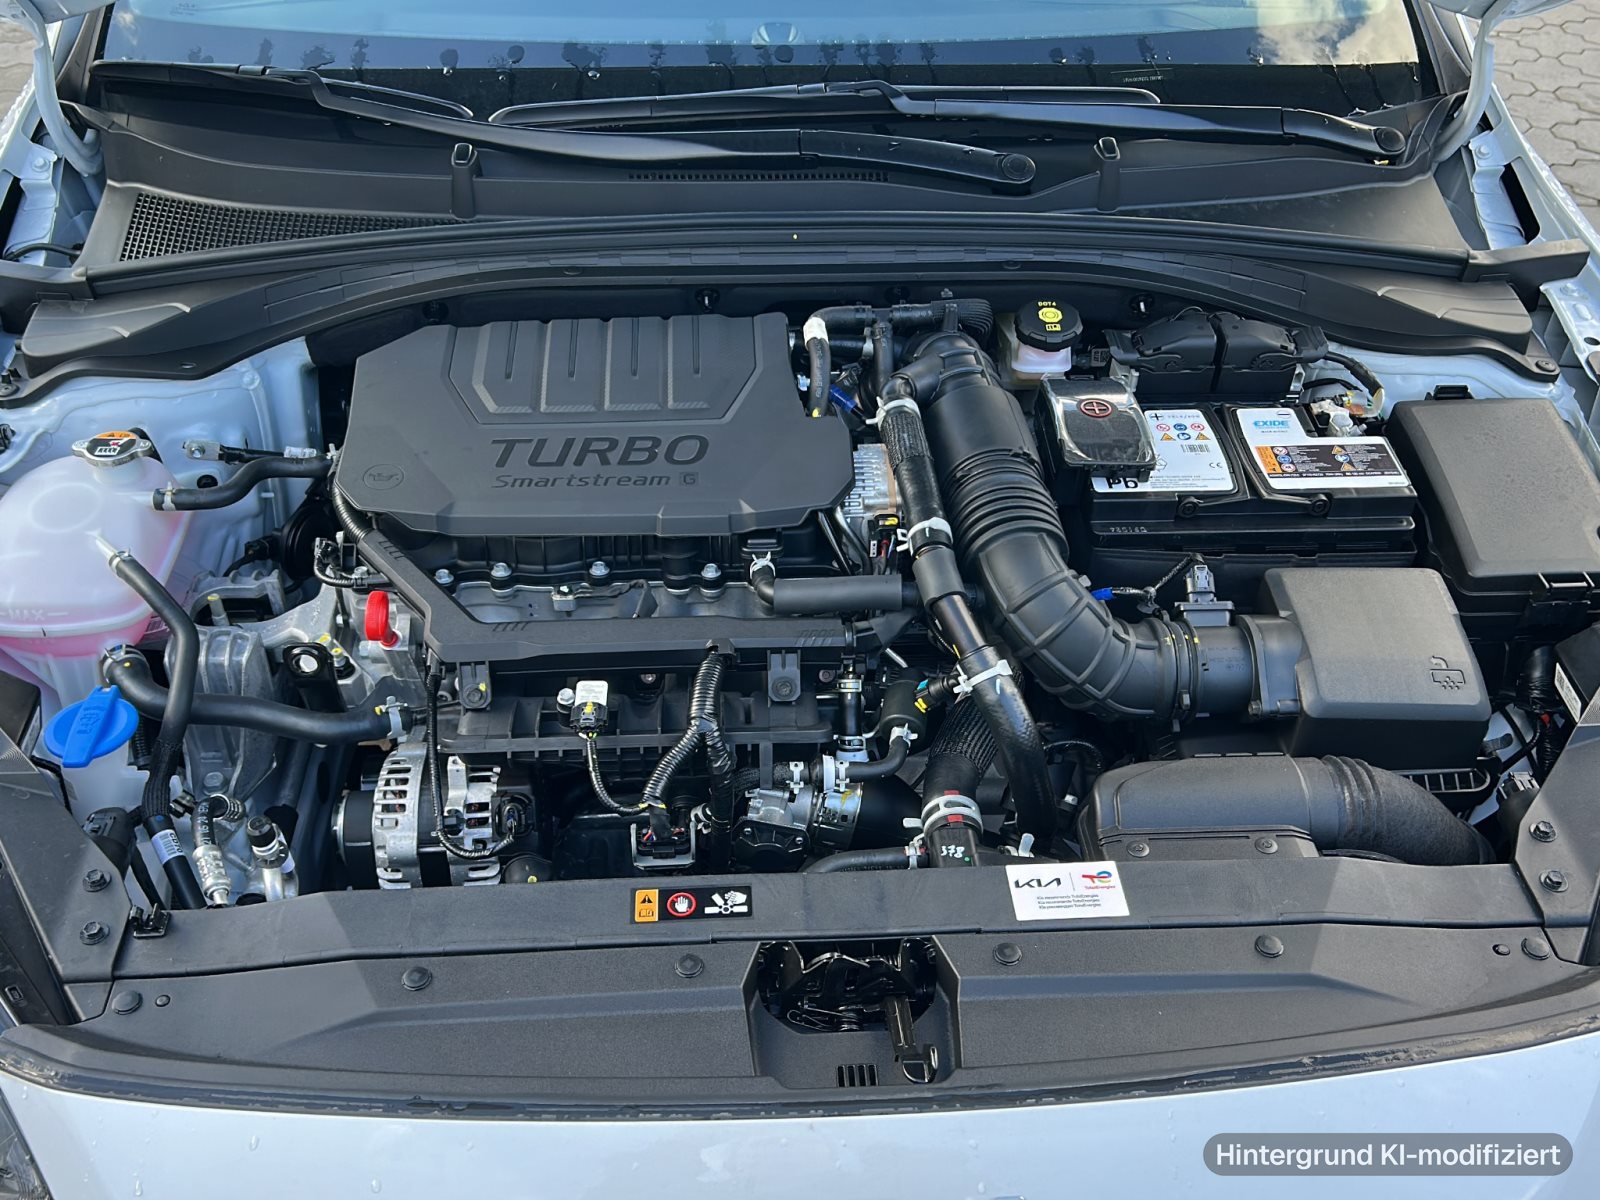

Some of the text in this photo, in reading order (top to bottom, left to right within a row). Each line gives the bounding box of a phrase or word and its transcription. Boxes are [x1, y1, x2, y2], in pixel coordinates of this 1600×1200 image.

[490, 434, 710, 468] TURBO
[491, 474, 671, 489] Smartstream
[941, 845, 965, 858] 378
[1014, 877, 1062, 888] KIA
